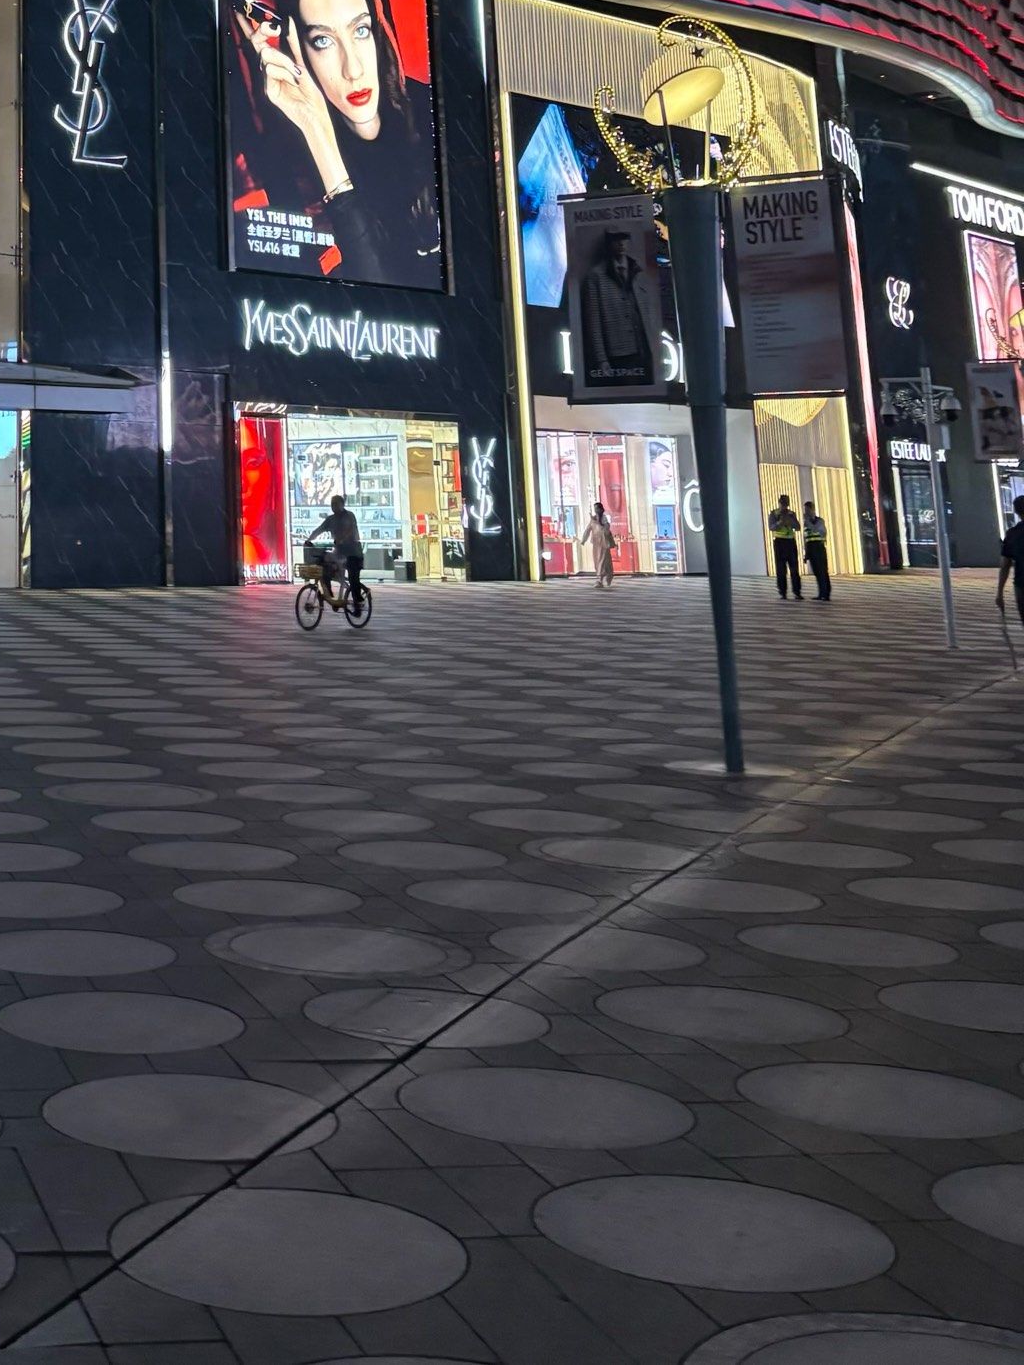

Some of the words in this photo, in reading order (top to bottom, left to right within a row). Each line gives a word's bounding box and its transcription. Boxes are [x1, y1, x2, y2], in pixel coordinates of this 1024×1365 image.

[574, 208, 611, 223] MAKING
[614, 204, 644, 219] STYLE
[742, 190, 819, 220] MAKING
[246, 208, 265, 222] YSL
[266, 210, 287, 225] THE
[288, 213, 313, 229] INKS
[745, 216, 804, 245] STYLE
